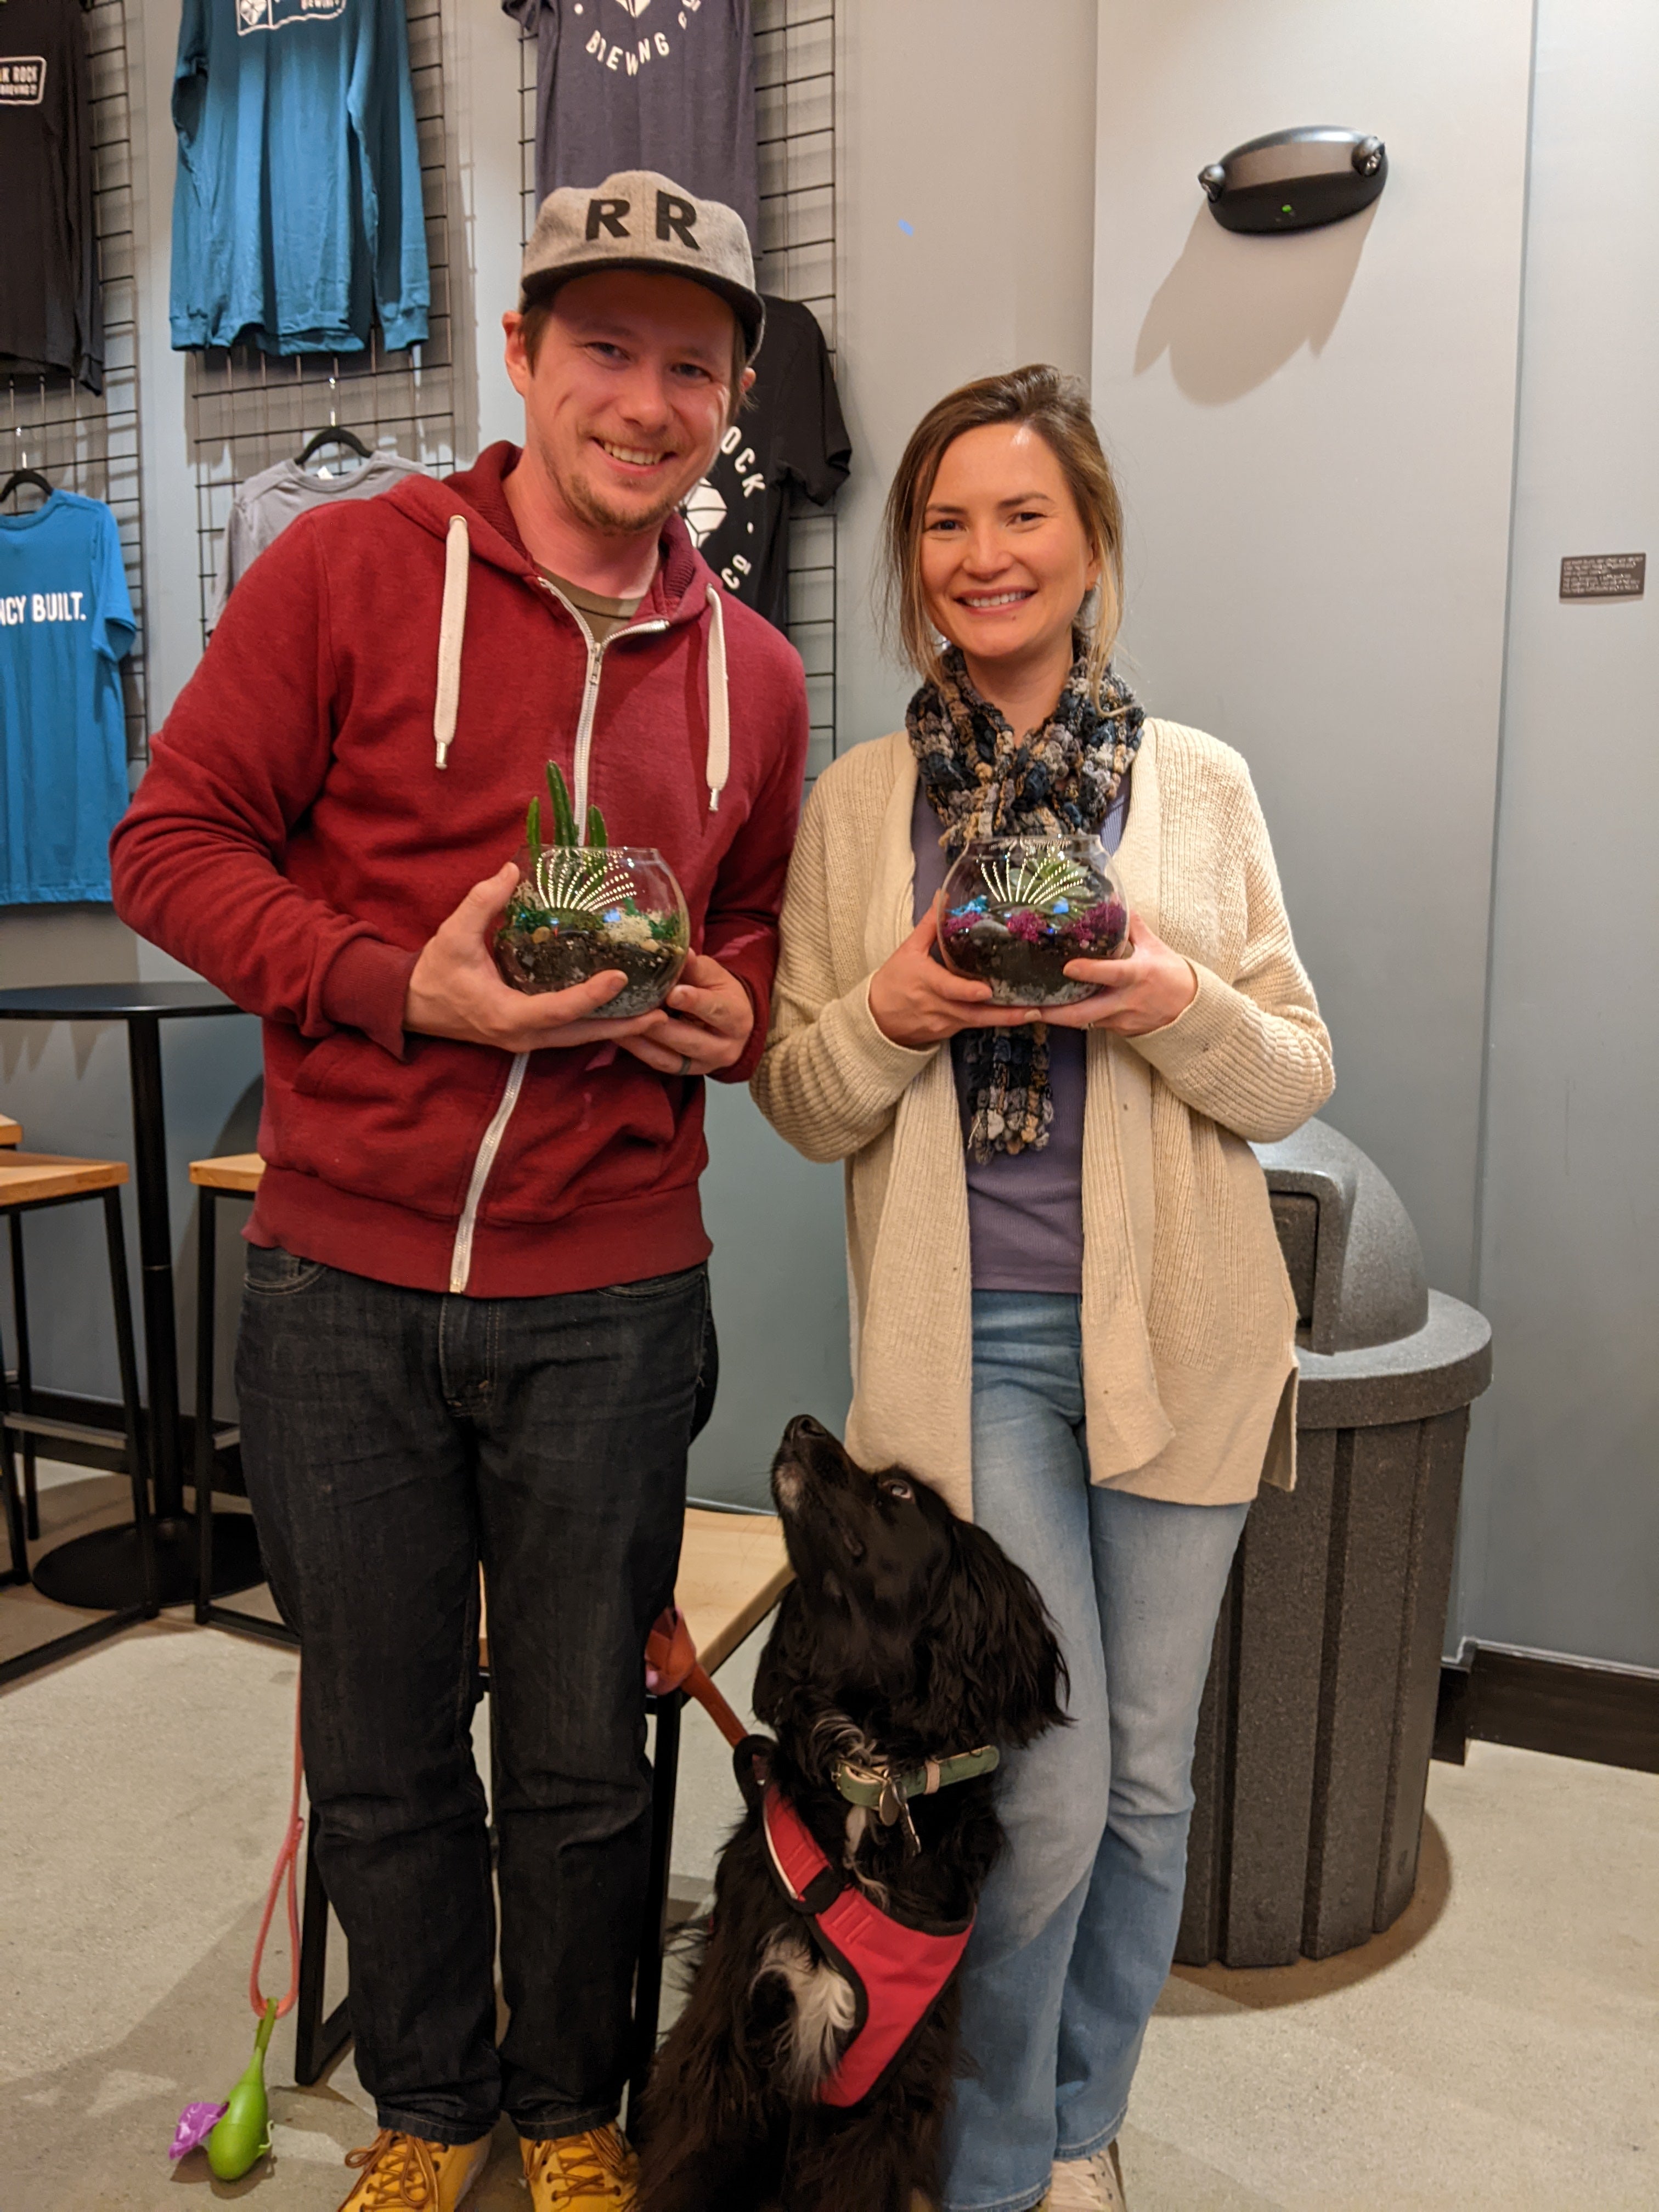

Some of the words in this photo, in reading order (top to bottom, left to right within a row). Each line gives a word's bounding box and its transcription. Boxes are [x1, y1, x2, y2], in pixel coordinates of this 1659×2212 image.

[0, 66, 10, 83] K
[585, 30, 670, 76] BEWNG
[585, 198, 630, 241] R
[656, 189, 701, 250] R
[720, 426, 766, 498] OCK
[32, 591, 87, 622] BUILT.
